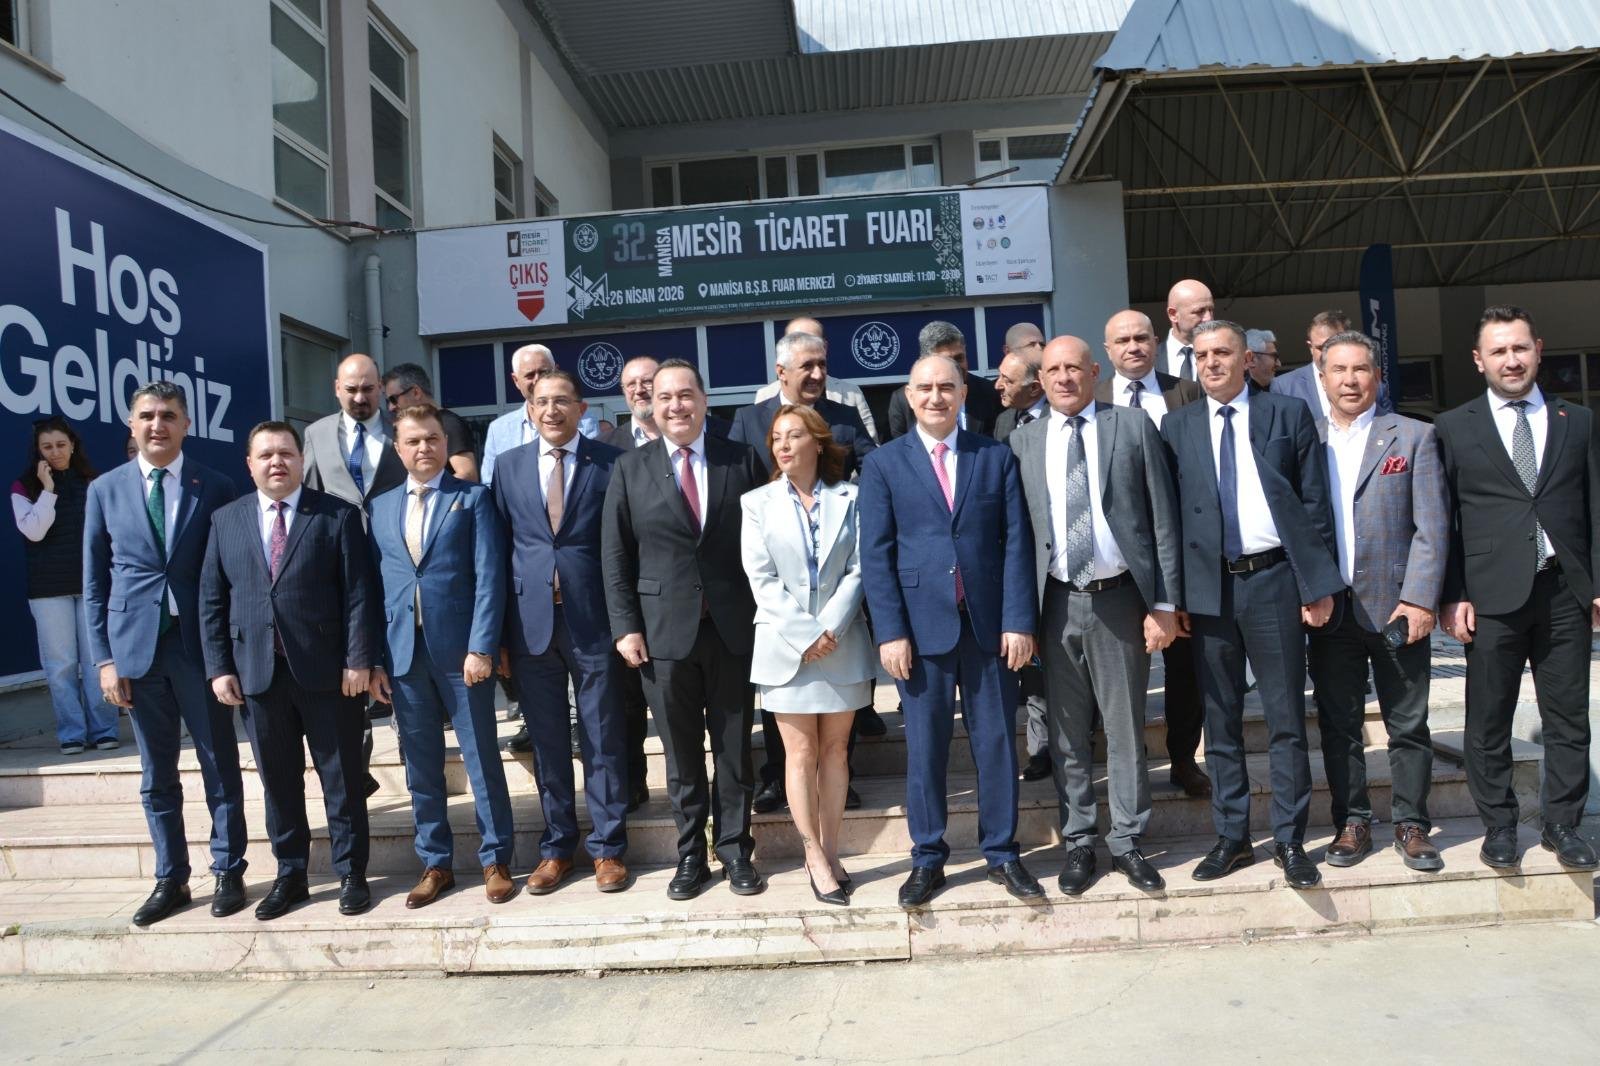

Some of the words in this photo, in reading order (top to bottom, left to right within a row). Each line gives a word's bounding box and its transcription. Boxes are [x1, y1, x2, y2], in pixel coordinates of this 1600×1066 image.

[613, 221, 654, 263] 32.
[672, 215, 743, 258] MESİR
[754, 211, 849, 252] TİCARET
[866, 207, 934, 246] FUARI
[656, 226, 673, 278] MANİSA
[55, 206, 182, 361] Hoş
[509, 262, 549, 289] ÇIKIŞ
[709, 278, 744, 297] MANİSA
[745, 279, 770, 296] B.Ş.B.
[772, 276, 796, 293] FUAR
[797, 272, 835, 291] MERKEZİ
[856, 273, 882, 285] ZİYARET
[916, 270, 935, 281] 11:00
[625, 286, 655, 305] NİSAN
[657, 285, 684, 302] 2026
